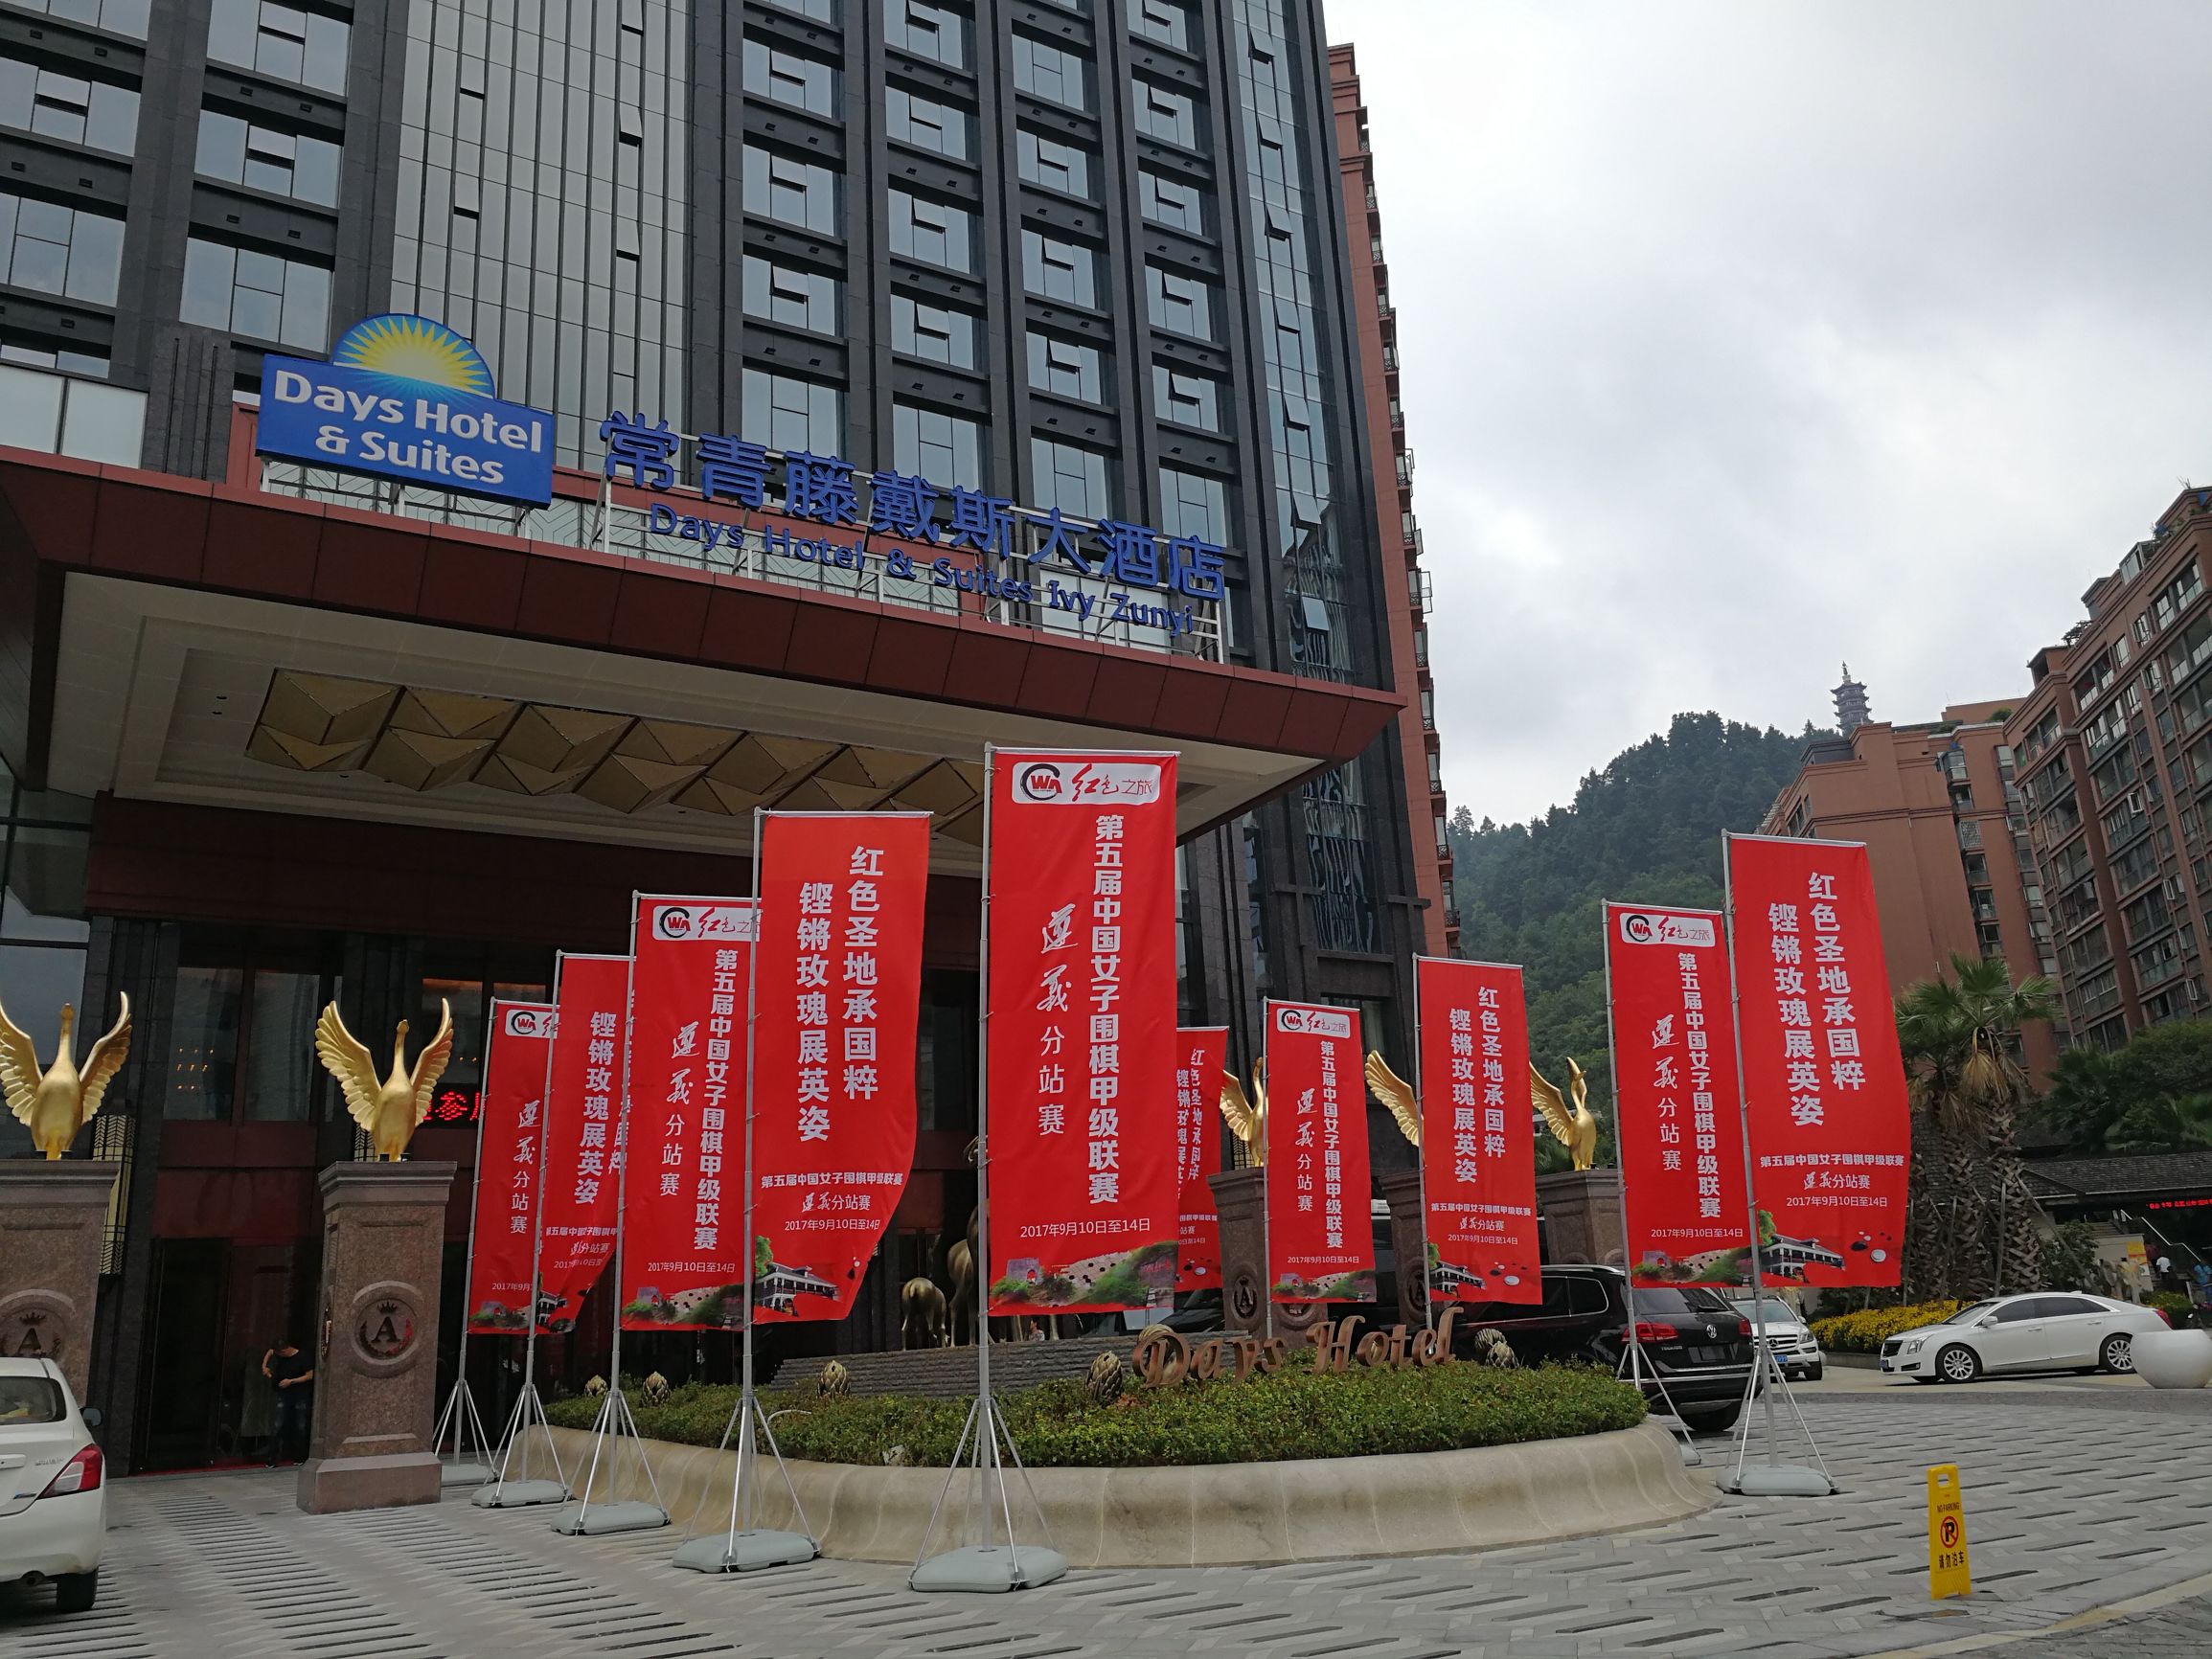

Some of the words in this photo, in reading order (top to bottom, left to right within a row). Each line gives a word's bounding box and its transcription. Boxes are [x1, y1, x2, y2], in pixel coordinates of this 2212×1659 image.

[273, 370, 405, 424] Days
[414, 398, 543, 454] Hotel
[315, 425, 352, 456] &
[359, 431, 506, 485] Suites
[600, 410, 1226, 602] 常青藤戴斯大酒店
[650, 502, 744, 552] Days
[765, 524, 866, 571] Hotel
[886, 547, 917, 581] &
[933, 557, 1034, 603] Suites
[1048, 580, 1096, 622] Ivy
[1109, 592, 1194, 638] Zunyi
[796, 882, 833, 1142] 铿锵玫瑰展英姿
[842, 845, 884, 1101] 红色圣地承国粹
[1088, 814, 1125, 1204] 第五届中国女子围棋甲级联赛
[1768, 902, 1824, 1126] 铿锵玫瑰展英姿
[1808, 872, 1866, 1091] 红色圣地承国粹
[574, 1011, 617, 1204] 铿锵玫瑰展英姿
[694, 949, 738, 1250] 第五届中国女子围棋甲级联赛
[1320, 1040, 1343, 1249] 第五届中国女子围棋甲级联赛
[1448, 1009, 1477, 1183] 铿锵玫瑰展英姿
[1478, 986, 1506, 1158] 红色圣地承国粹
[1677, 952, 1722, 1218] 第五届中国女子围棋甲级联赛
[761, 1171, 903, 1189] 第五届中国女子围棋甲级联赛
[784, 1218, 880, 1232] 2017年9月10日至14日
[1019, 1217, 1151, 1239] 2017年9月10日至14日
[1760, 1153, 1904, 1169] 第五届中国女子围棋甲级联赛
[1787, 1195, 1888, 1208] 2017年9月10日至14日
[491, 1283, 533, 1291] 2017年9月
[1303, 1307, 1465, 1374] Hotel
